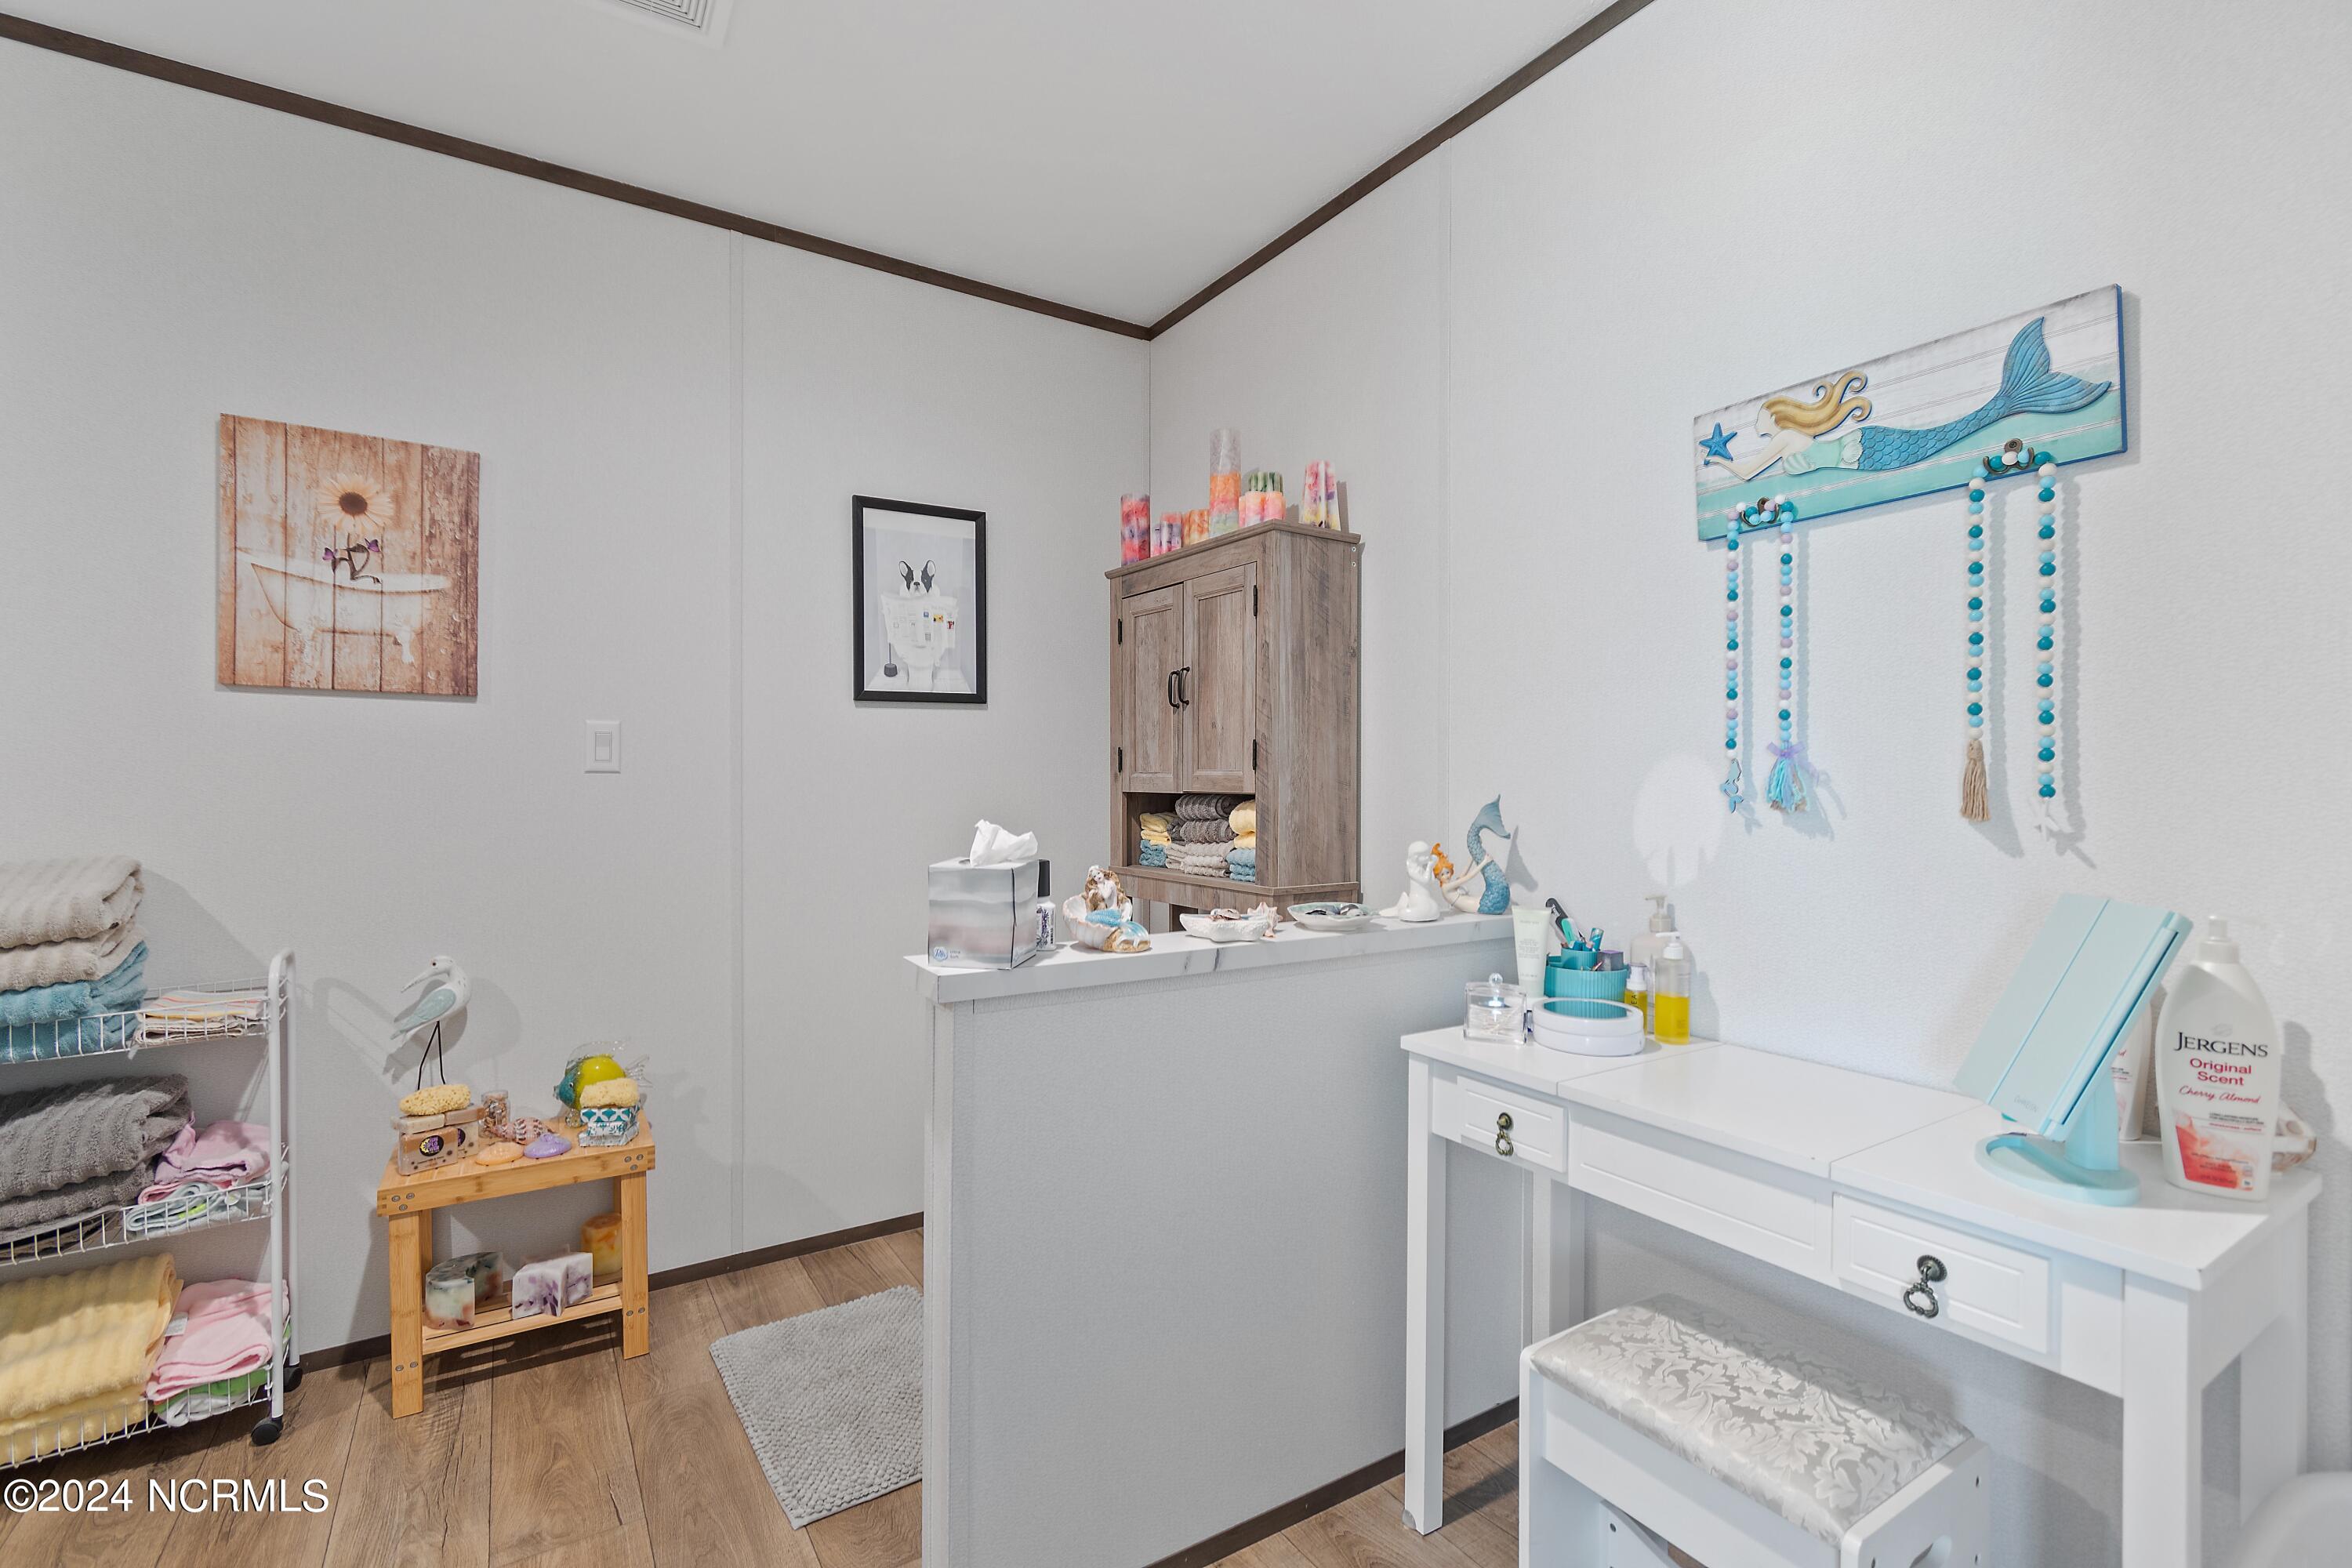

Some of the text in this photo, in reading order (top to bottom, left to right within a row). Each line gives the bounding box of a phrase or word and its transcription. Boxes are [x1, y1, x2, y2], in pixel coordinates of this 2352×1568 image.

[2174, 1032, 2267, 1057] JERGENS
[2190, 1058, 2251, 1073] Original
[2197, 1071, 2243, 1085] Scent
[2179, 1085, 2214, 1101] Cherry
[2219, 1092, 2260, 1103] Almond
